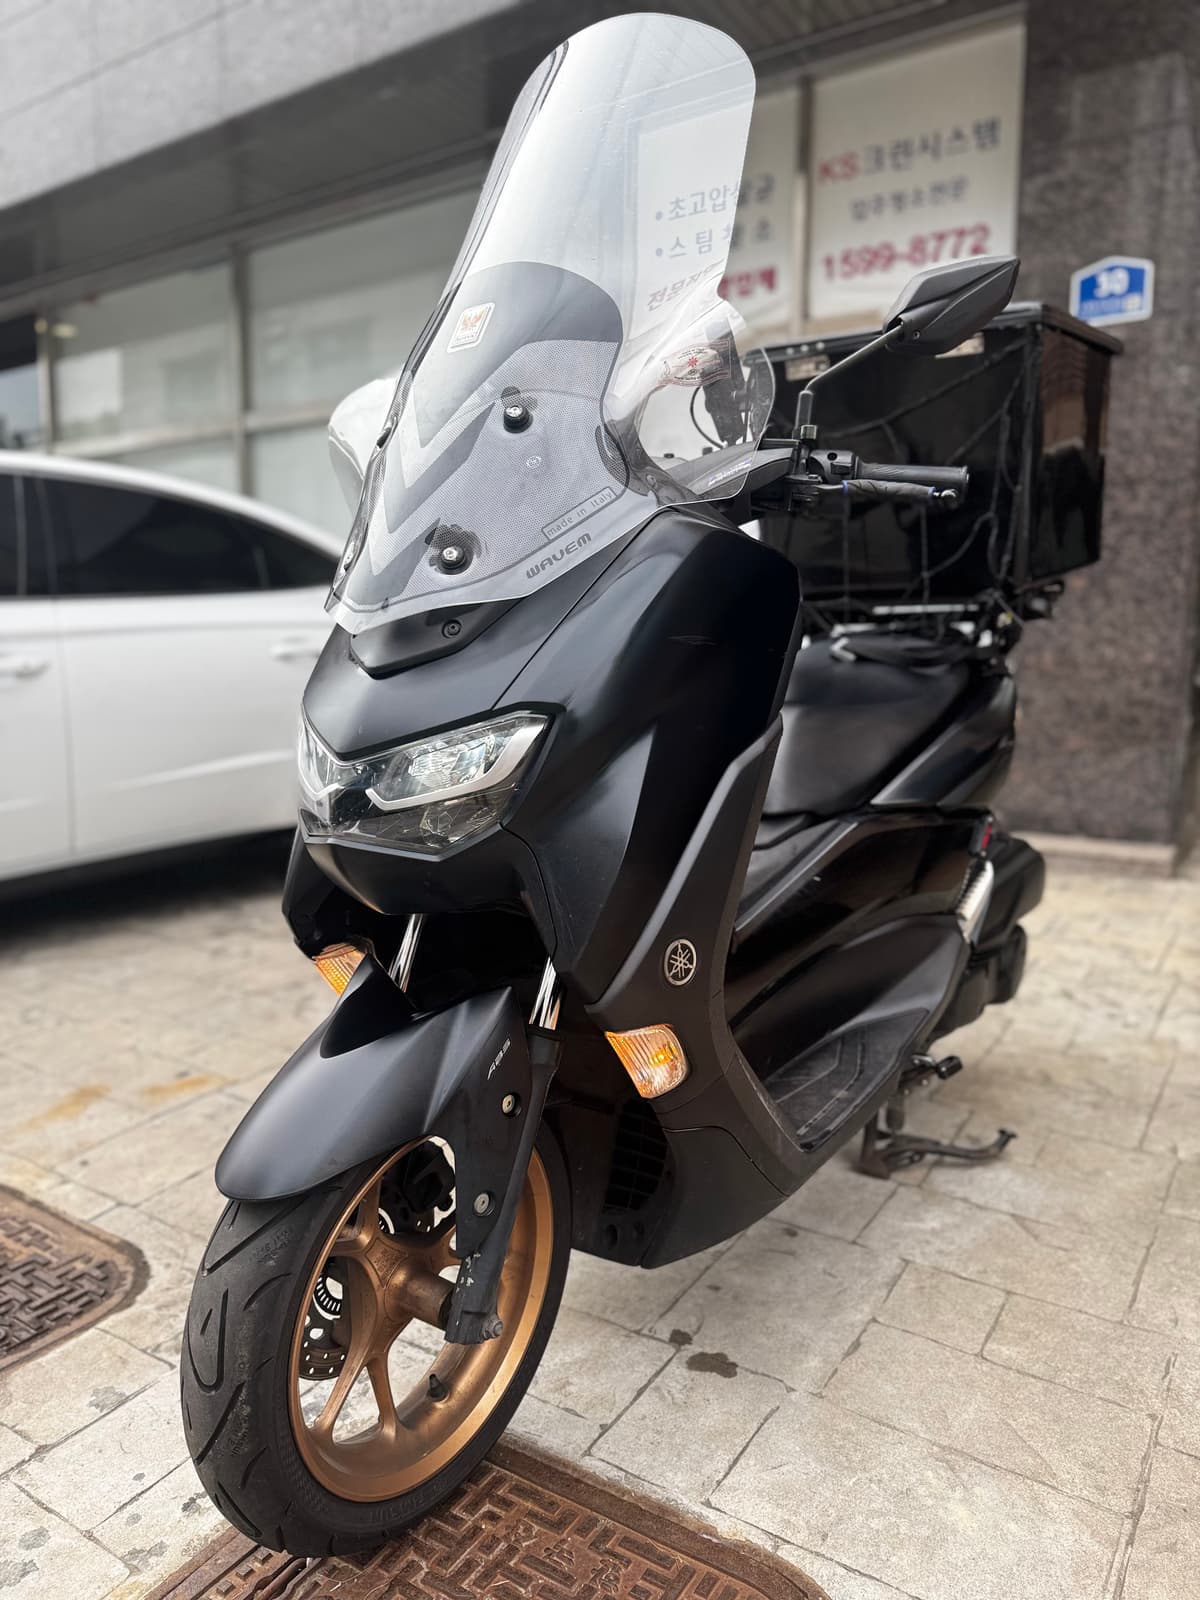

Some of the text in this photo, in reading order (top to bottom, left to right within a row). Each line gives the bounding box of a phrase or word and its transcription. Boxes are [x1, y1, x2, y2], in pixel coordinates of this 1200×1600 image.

[822, 222, 991, 281] 1599-8772
[546, 490, 614, 537] made in Italy
[525, 532, 592, 579] WAVEM
